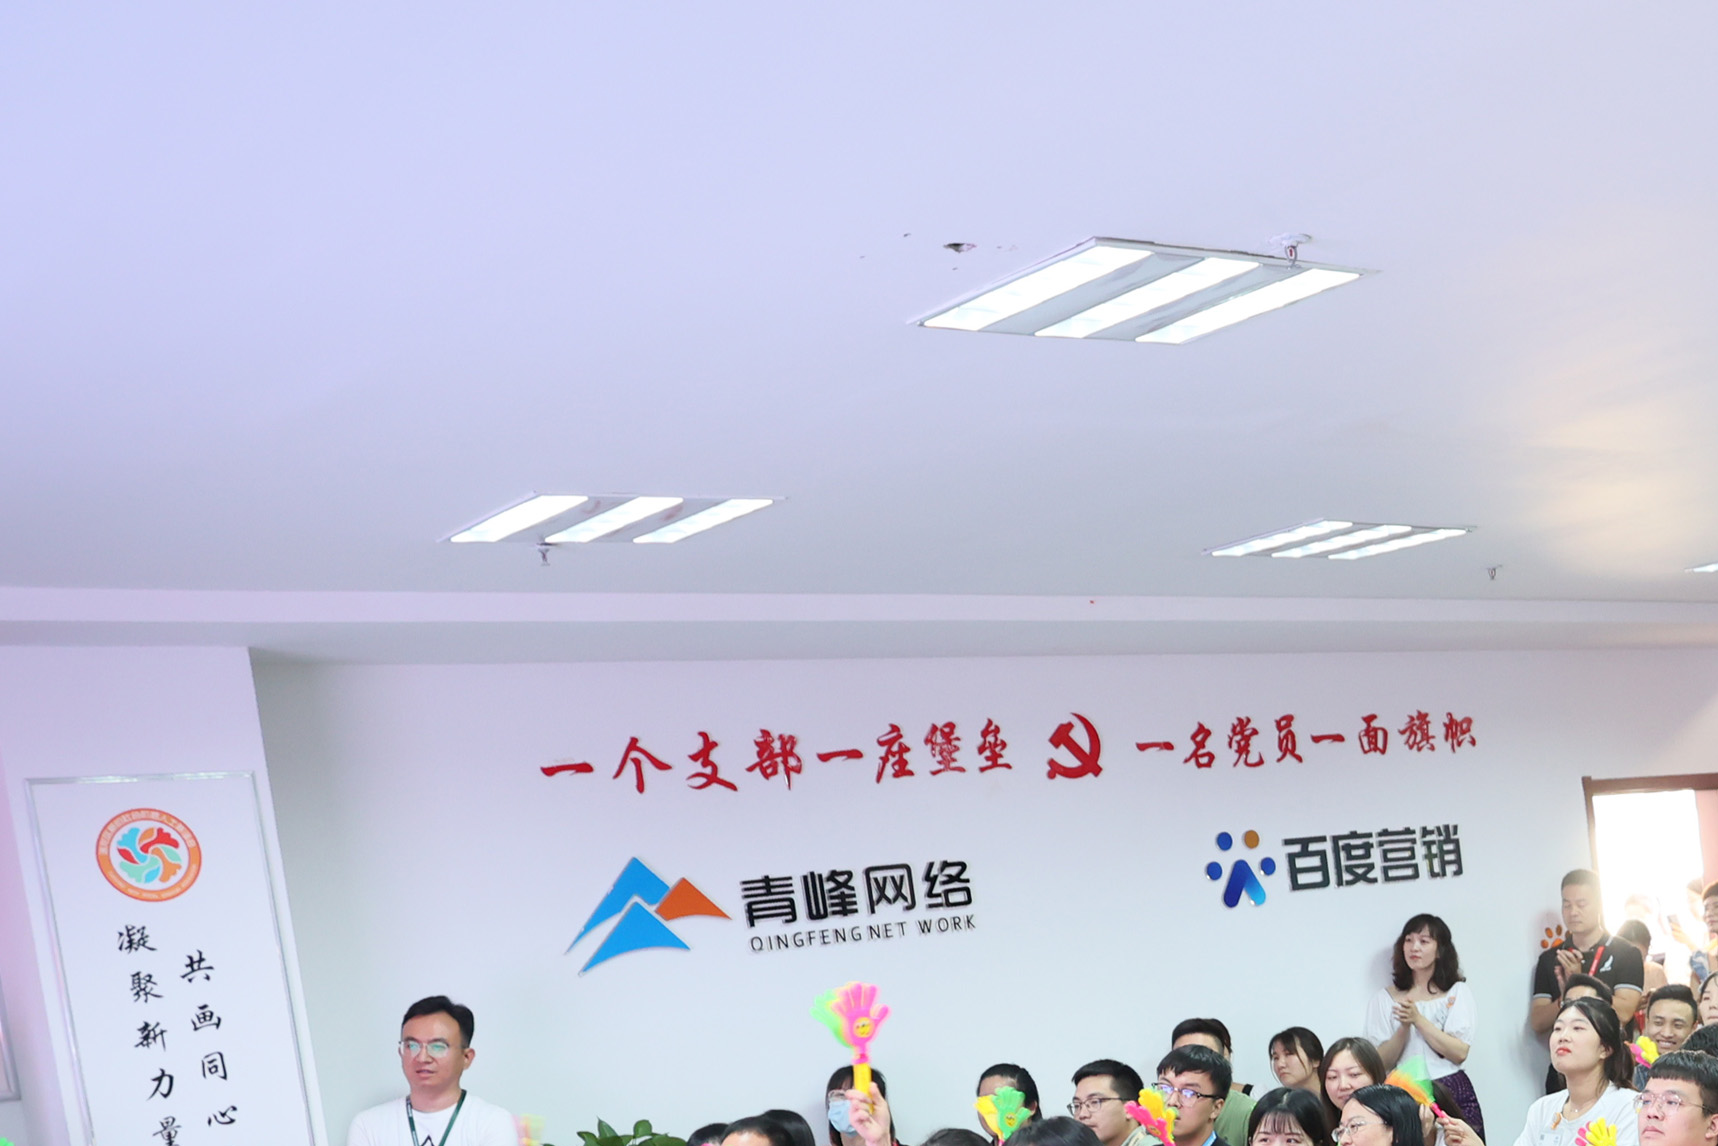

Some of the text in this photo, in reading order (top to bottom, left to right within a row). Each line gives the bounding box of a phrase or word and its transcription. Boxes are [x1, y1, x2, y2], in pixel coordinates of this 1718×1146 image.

[540, 710, 1477, 794] 一个支部一座堡垒 一名党员一面旗帜
[1282, 824, 1464, 891] 百度营销
[740, 861, 974, 927] 青峰网络
[917, 914, 977, 933] WORK
